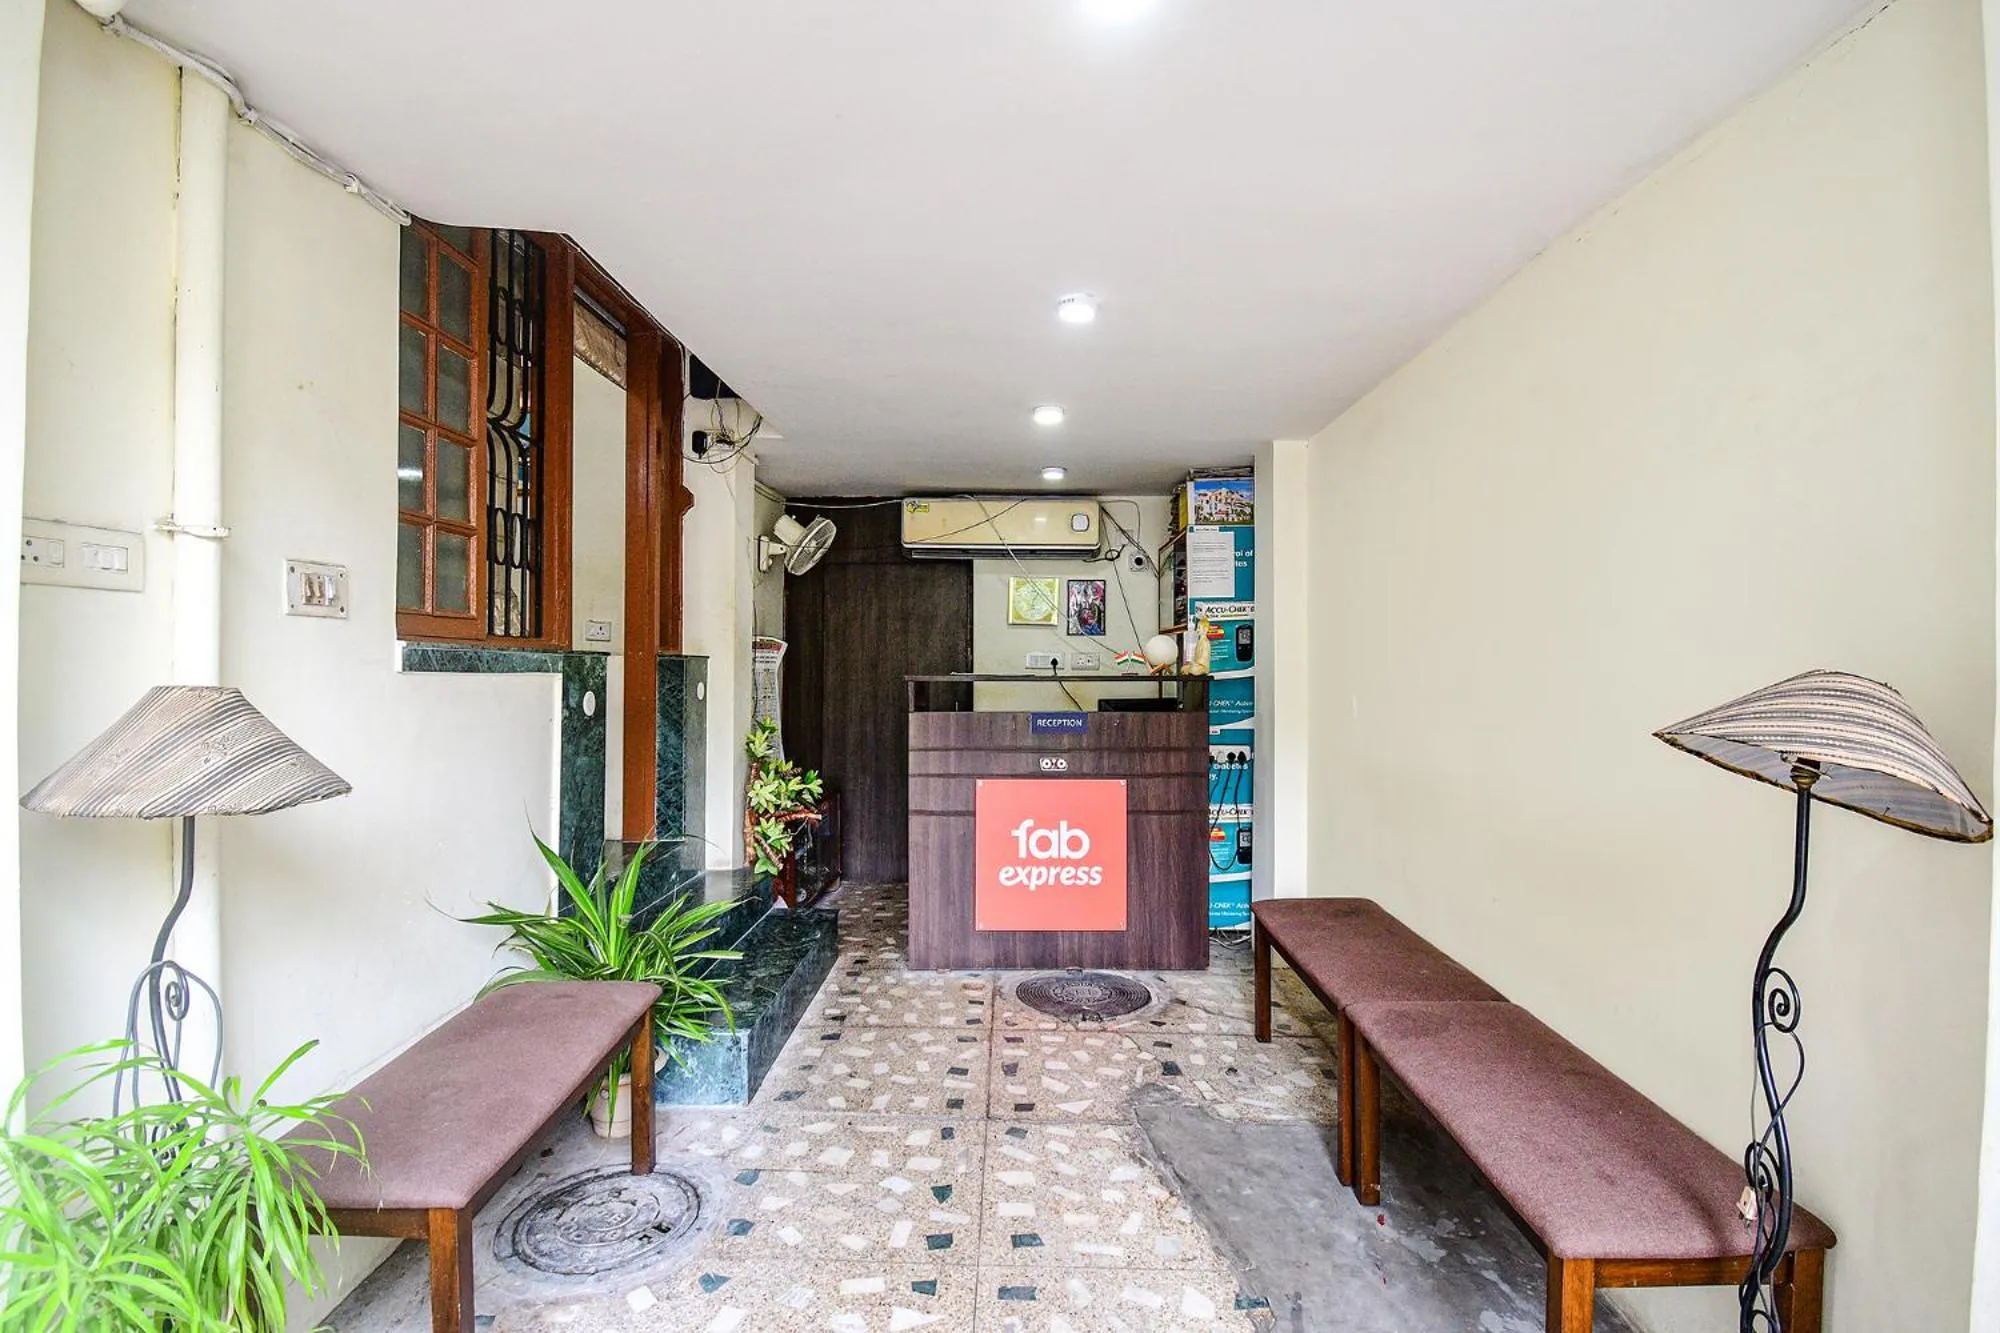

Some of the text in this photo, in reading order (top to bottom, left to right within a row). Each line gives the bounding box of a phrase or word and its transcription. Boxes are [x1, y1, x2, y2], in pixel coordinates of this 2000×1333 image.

[1036, 719, 1083, 728] RECEPTION
[1010, 818, 1091, 860] fab
[998, 864, 1104, 892] express
